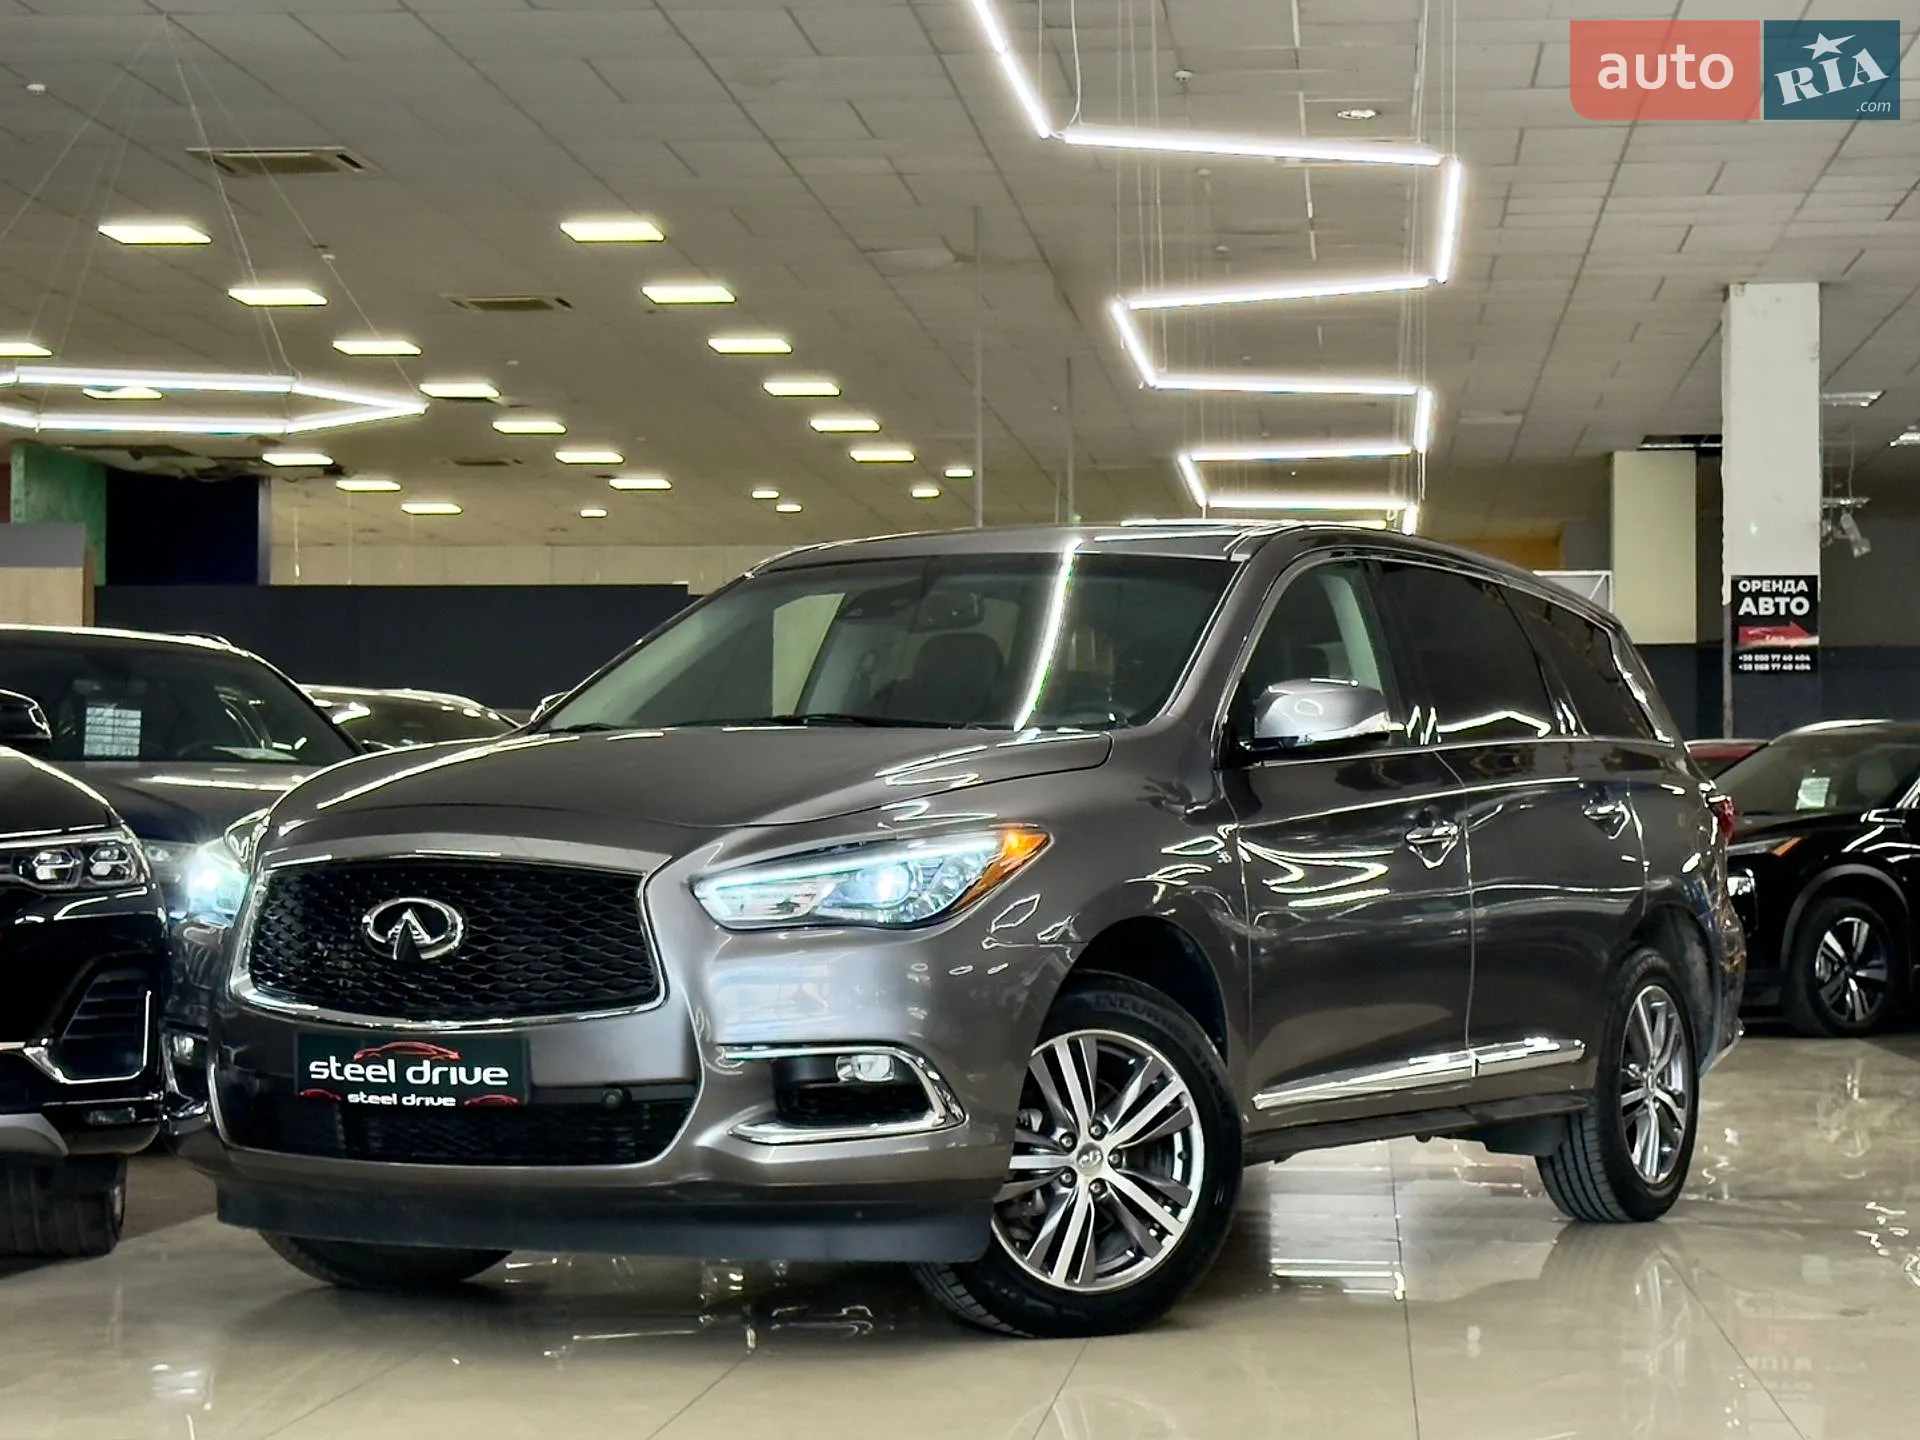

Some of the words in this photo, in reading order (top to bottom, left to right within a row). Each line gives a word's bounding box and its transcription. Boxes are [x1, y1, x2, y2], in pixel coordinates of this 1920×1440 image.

[1738, 580, 1809, 594] ОРЕНДА
[1738, 596, 1810, 616] АВТО
[309, 1055, 396, 1083] steel
[406, 1059, 509, 1086] drive
[347, 1091, 398, 1106] steel
[402, 1093, 457, 1107] drive
